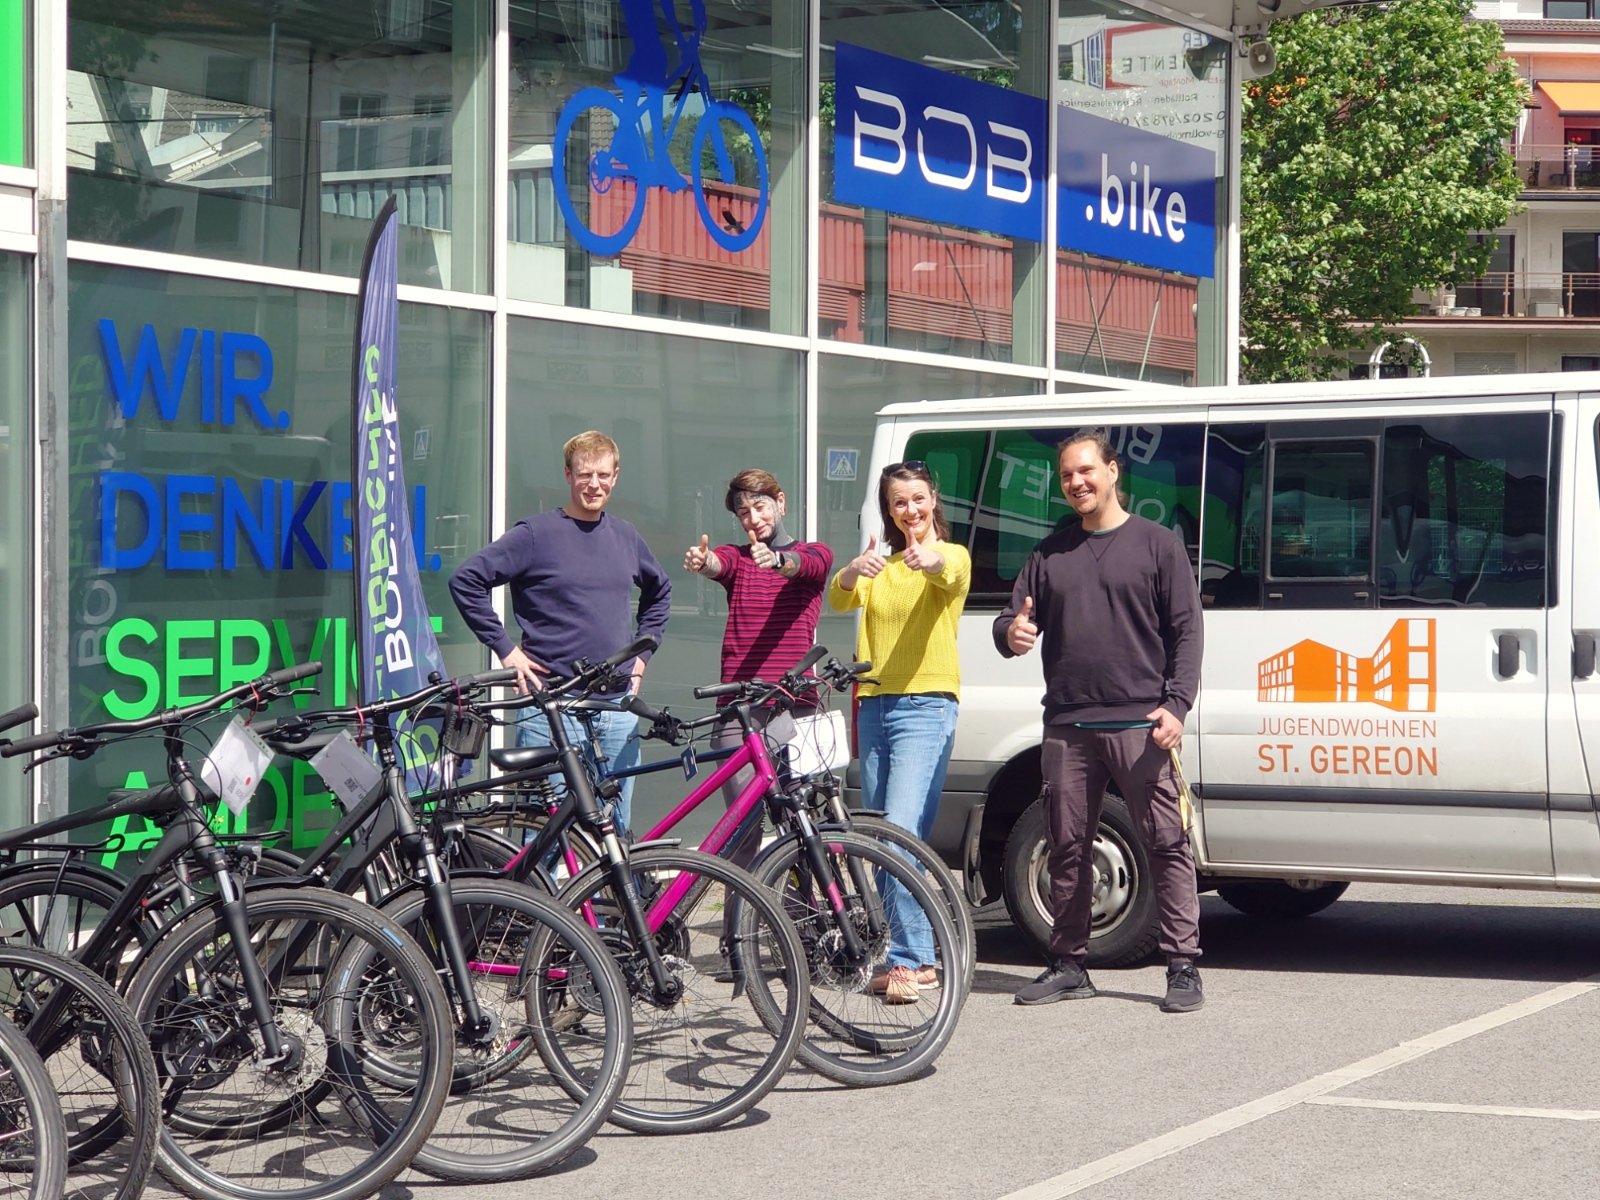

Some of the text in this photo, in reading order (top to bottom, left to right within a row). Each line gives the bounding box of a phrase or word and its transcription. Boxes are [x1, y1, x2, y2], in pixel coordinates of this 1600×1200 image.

[854, 85, 1187, 243] BOB .bike
[100, 319, 290, 429] WIR.
[103, 616, 442, 721] SERVI
[1257, 717, 1437, 738] JUGENDWOHNEN
[1257, 744, 1438, 776] ST. GEREON
